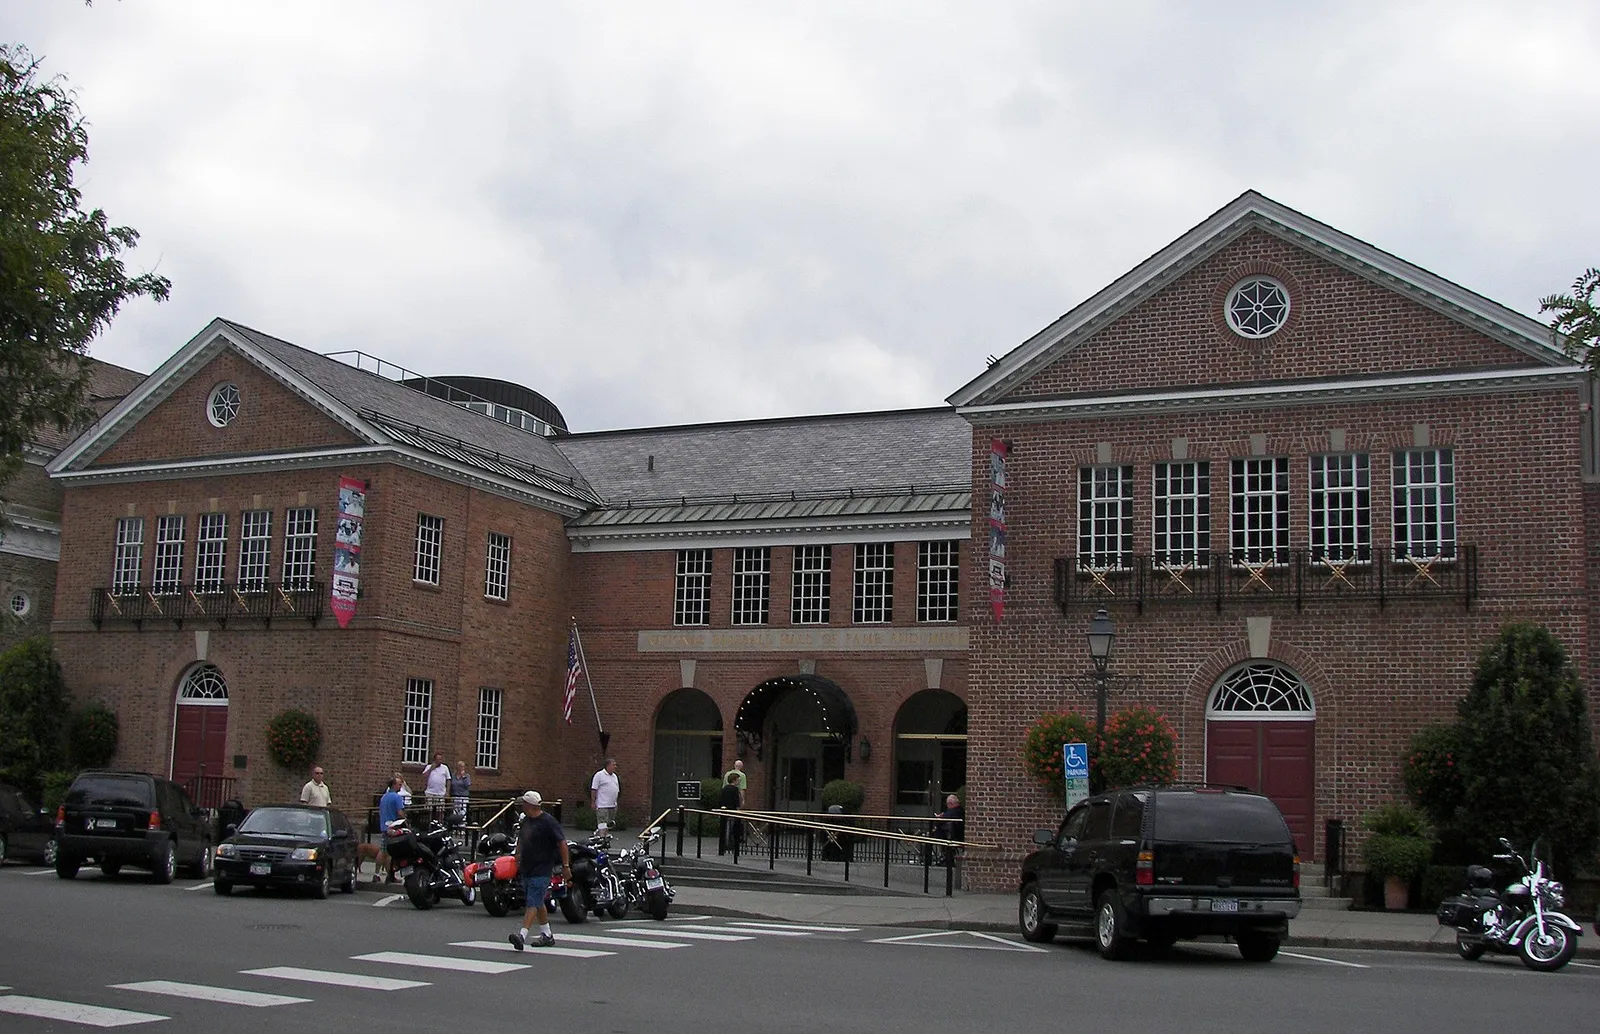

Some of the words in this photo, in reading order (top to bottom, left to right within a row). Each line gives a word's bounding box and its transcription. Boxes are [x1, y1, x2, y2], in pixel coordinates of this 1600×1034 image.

[821, 633, 839, 645] OF
[845, 632, 883, 645] FAME
[891, 632, 920, 644] AND
[1067, 768, 1087, 776] PARKING
